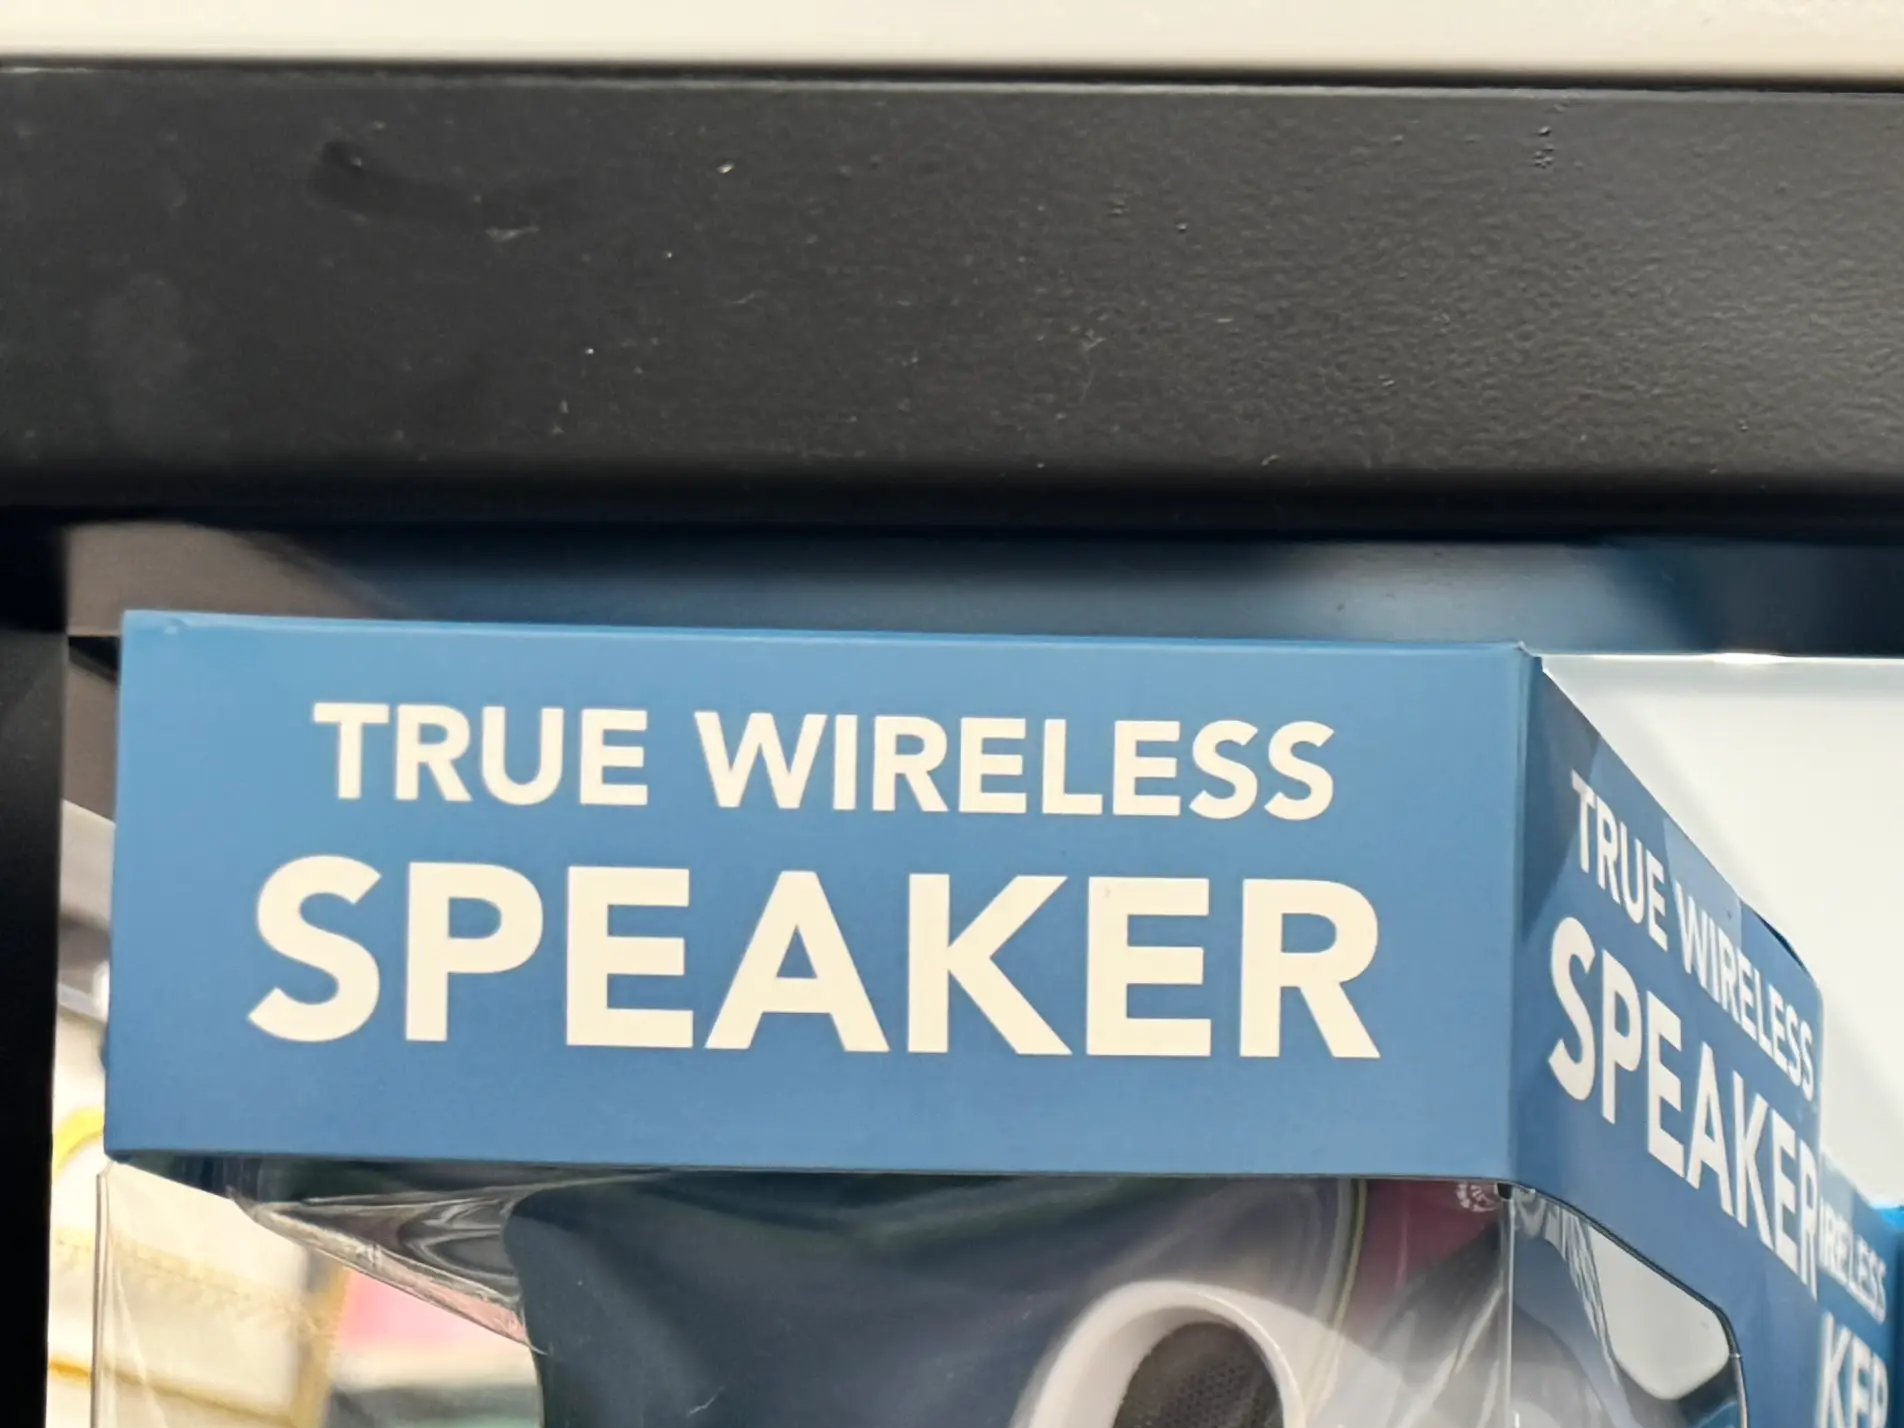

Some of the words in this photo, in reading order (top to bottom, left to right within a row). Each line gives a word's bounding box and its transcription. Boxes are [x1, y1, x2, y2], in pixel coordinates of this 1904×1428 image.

[313, 703, 649, 806] TRUE
[695, 710, 1336, 821] WIRELESS
[247, 854, 1381, 1059] SPEAKER
[1571, 770, 1669, 953] TRUE
[1673, 880, 1815, 1103] WIRELESS
[1548, 916, 1819, 1301] SPEAKER
